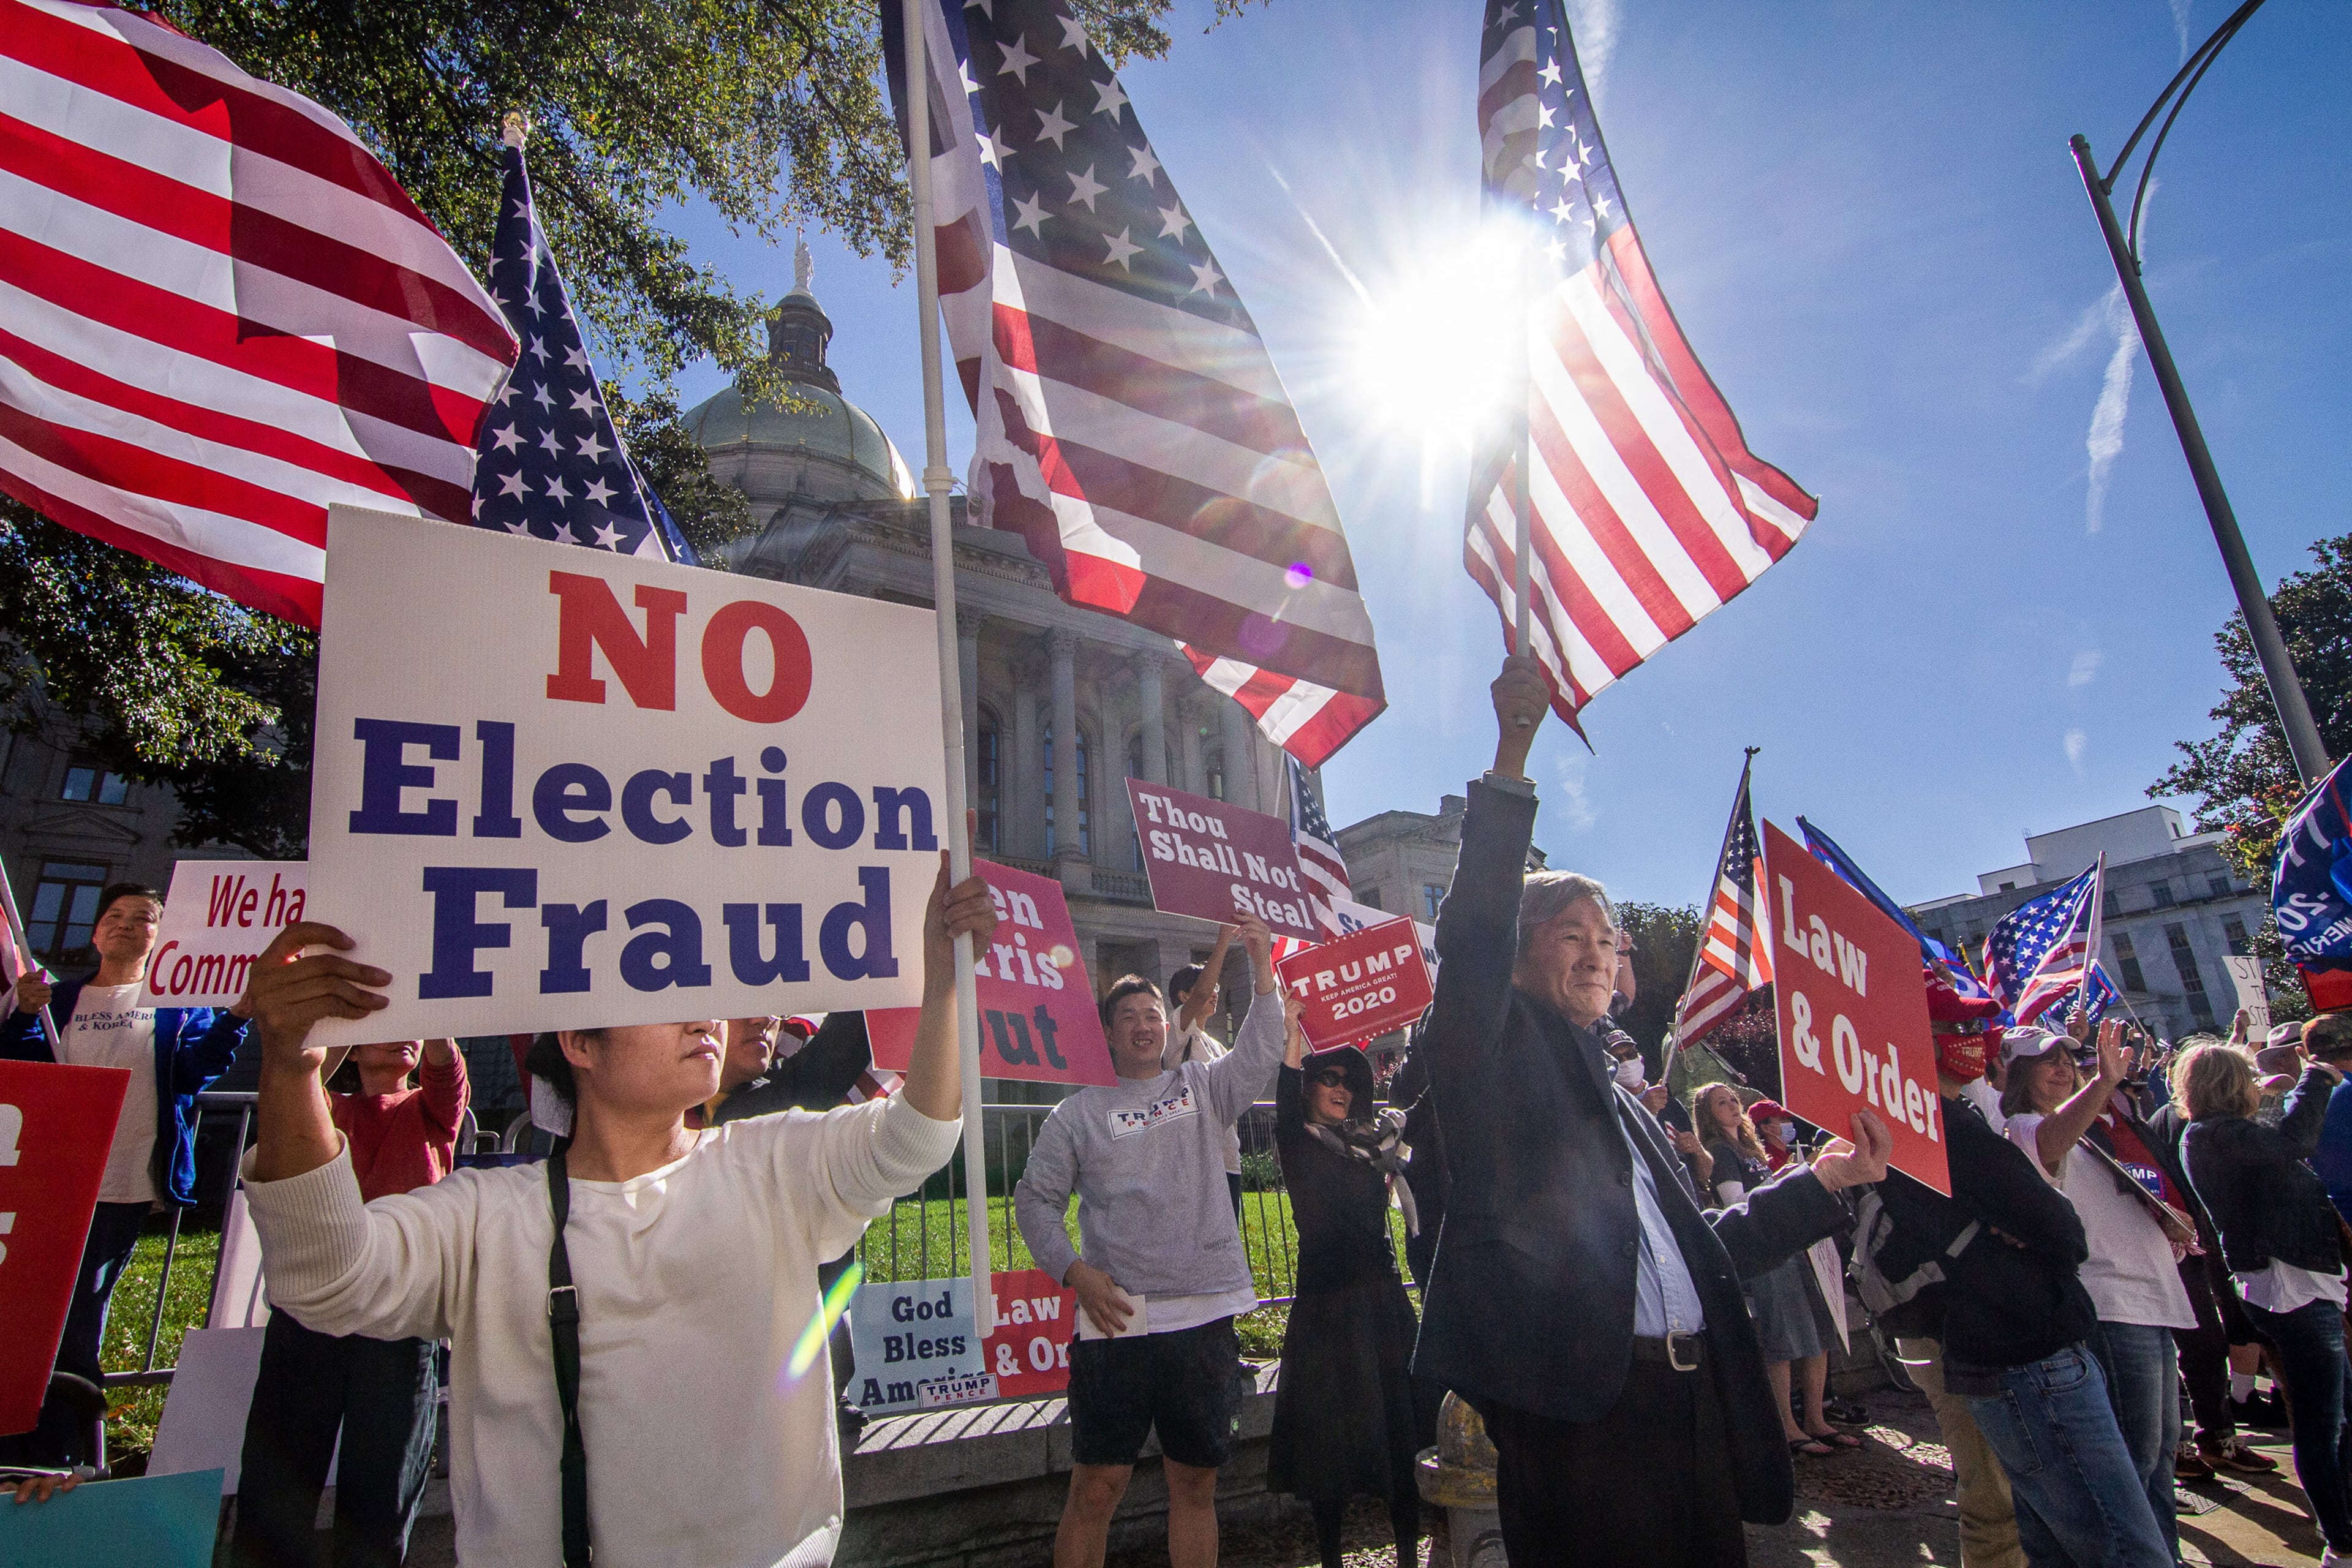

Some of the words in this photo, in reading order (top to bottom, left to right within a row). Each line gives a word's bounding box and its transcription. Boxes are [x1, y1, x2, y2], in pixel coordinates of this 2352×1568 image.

[546, 570, 812, 724] NO
[349, 717, 938, 852] Election
[1139, 792, 1228, 840] Thou
[1149, 830, 1242, 877] Shall
[1243, 851, 1301, 892] Not
[207, 875, 258, 928] We
[1231, 883, 1314, 930] Steal
[418, 865, 899, 1000] Fraud
[1779, 873, 1867, 998] Law
[1291, 944, 1412, 997] TRUMP
[1321, 992, 1338, 1003] KEEP
[1341, 981, 1373, 996] AMERICA
[1373, 973, 1397, 985] GREAT!
[75, 1011, 112, 1022] BLESS
[93, 1019, 133, 1030] KOREA
[1332, 986, 1396, 1020] 2020
[978, 1004, 1068, 1069] ut
[1792, 991, 1826, 1076] &
[1832, 1014, 1939, 1143] Order
[892, 1291, 953, 1322] God
[992, 1294, 1061, 1327] Law
[883, 1332, 966, 1363] Bless
[996, 1343, 1022, 1377] &
[927, 1378, 990, 1395] TRUMP
[935, 1389, 986, 1401] PENCE
